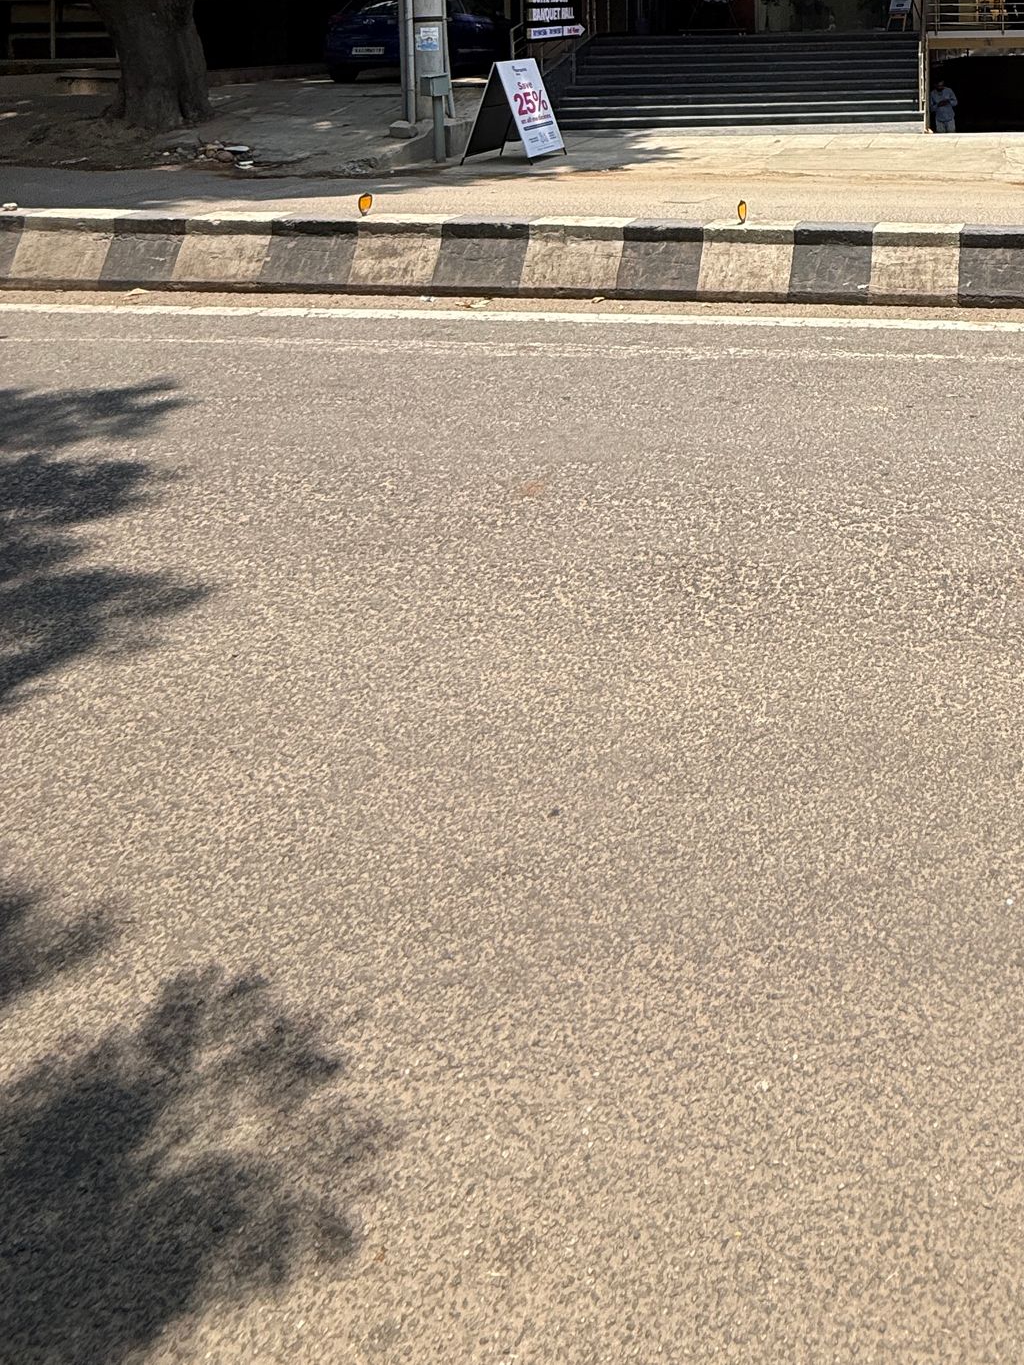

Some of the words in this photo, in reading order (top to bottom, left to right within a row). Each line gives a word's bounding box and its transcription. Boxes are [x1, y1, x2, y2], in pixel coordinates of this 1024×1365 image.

[533, 8, 560, 22] BANQUET
[517, 82, 533, 90] Save
[513, 90, 548, 116] 25%
